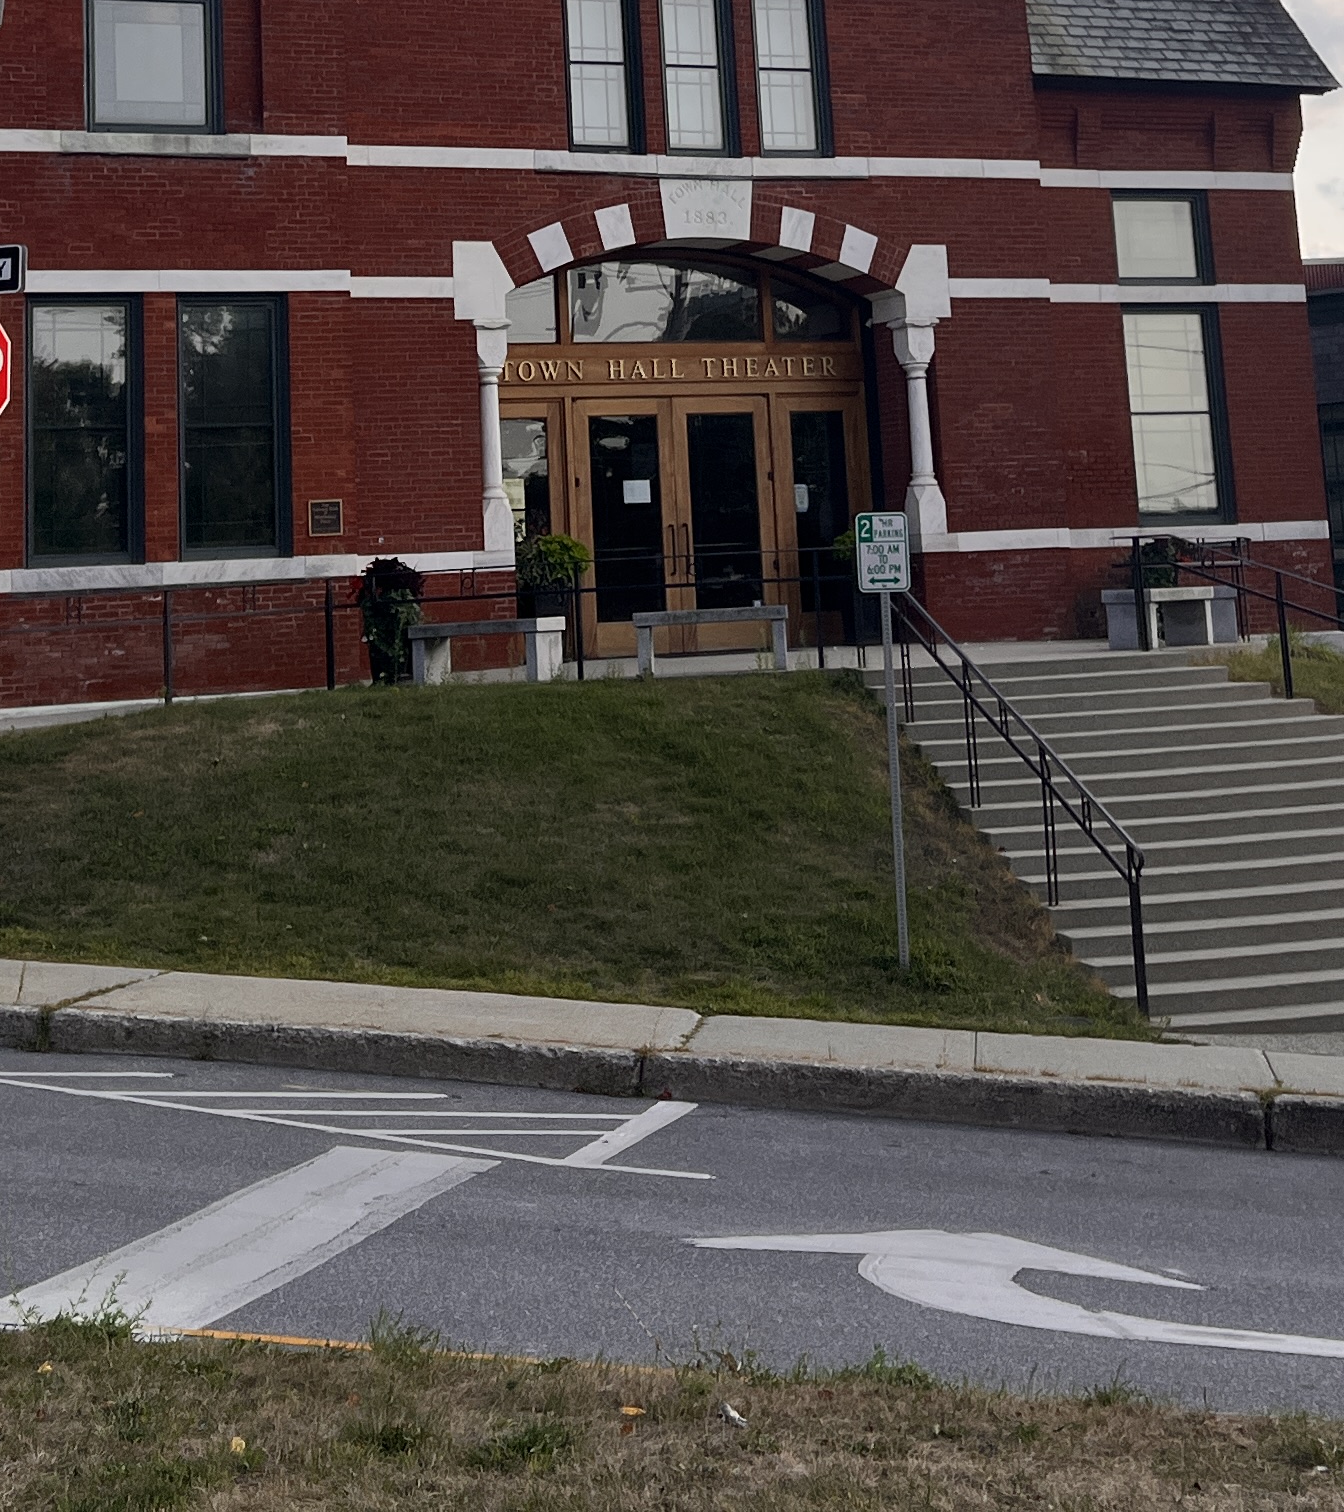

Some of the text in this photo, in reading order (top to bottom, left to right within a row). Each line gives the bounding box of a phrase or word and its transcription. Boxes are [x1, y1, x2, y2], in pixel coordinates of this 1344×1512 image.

[669, 179, 746, 209] TOWN HALL
[503, 356, 837, 382] TOWN HALL THEATER
[860, 519, 893, 537] 2 HR
[874, 529, 903, 538] PARKING
[866, 544, 899, 554] 7:00 AM
[878, 555, 888, 564] TO
[867, 564, 901, 574] 6:00 PM
